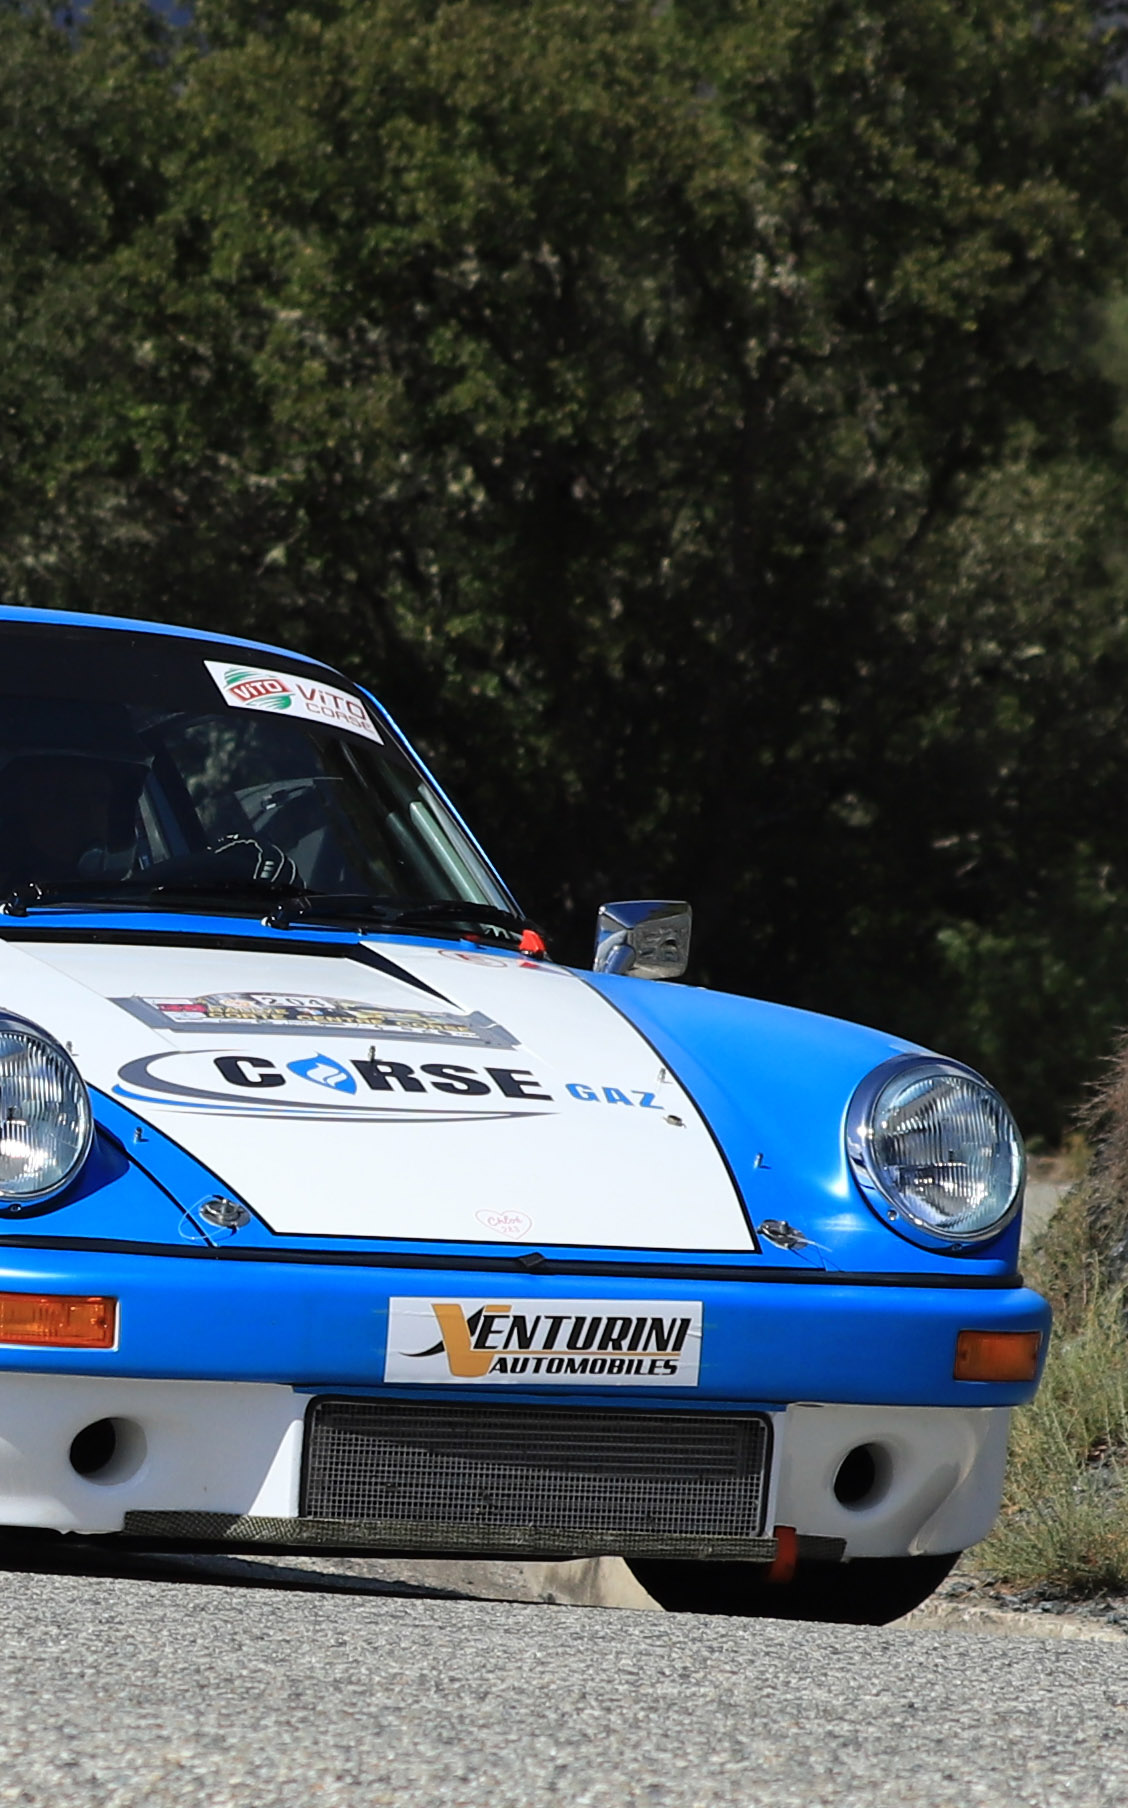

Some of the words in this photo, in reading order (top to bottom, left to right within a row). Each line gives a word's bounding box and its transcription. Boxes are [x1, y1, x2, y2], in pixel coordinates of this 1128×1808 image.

[565, 1082, 666, 1111] GAZ
[428, 1303, 692, 1378] VENTURINI
[489, 1356, 679, 1377] AUTOMOBILES
